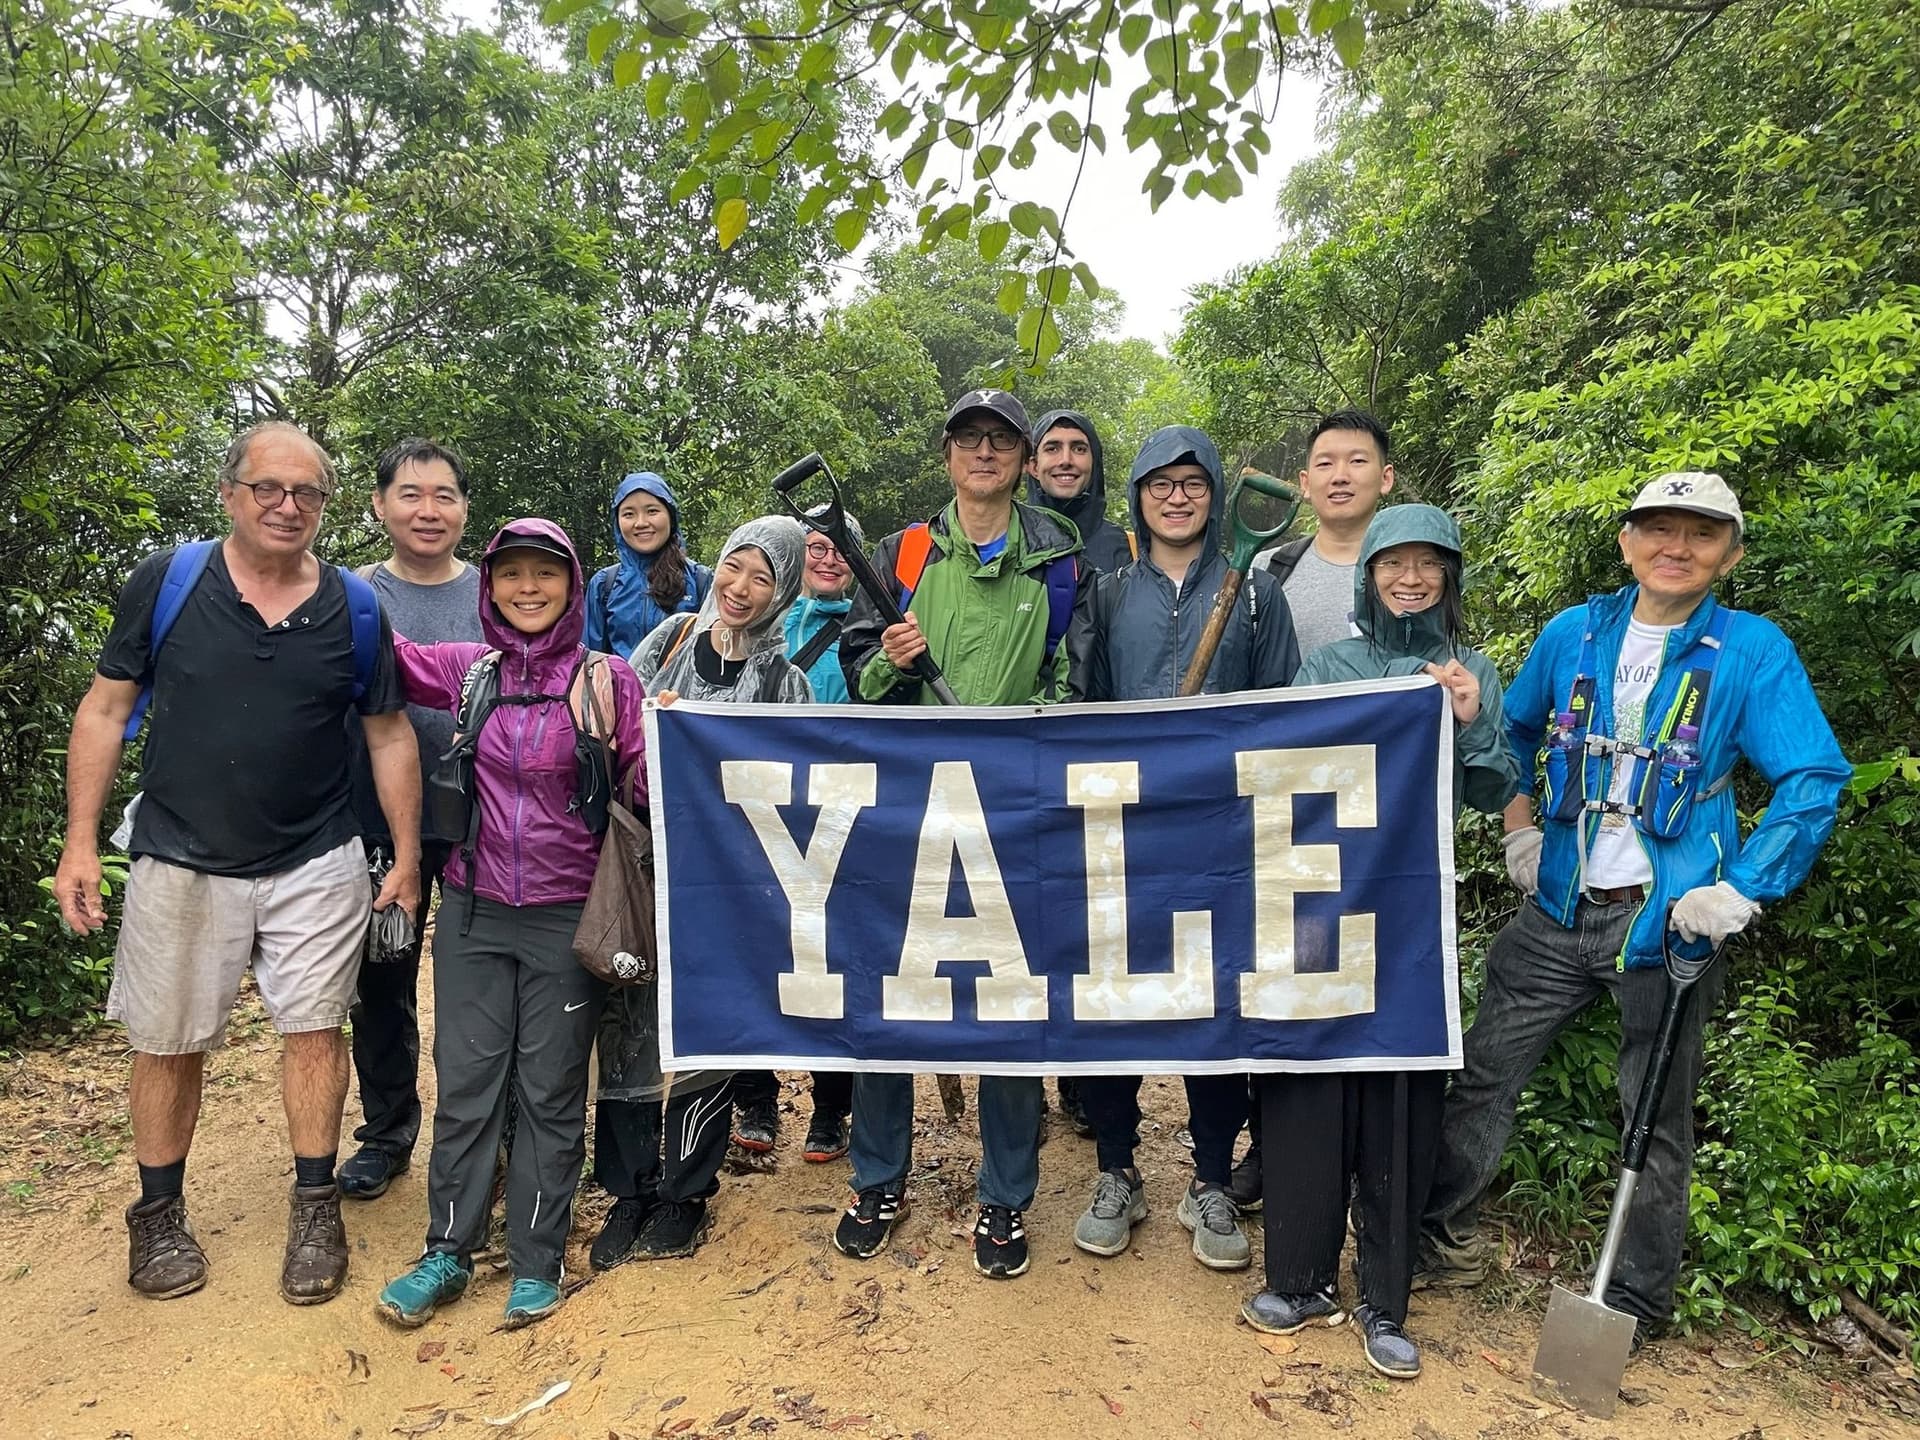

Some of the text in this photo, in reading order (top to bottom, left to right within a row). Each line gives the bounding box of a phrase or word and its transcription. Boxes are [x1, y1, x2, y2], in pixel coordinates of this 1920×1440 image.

[975, 390, 1000, 405] Y
[1668, 481, 1693, 496] Y
[1615, 665, 1657, 684] AY OF
[1680, 687, 1700, 726] AONIJI
[720, 743, 1377, 1021] YALE
